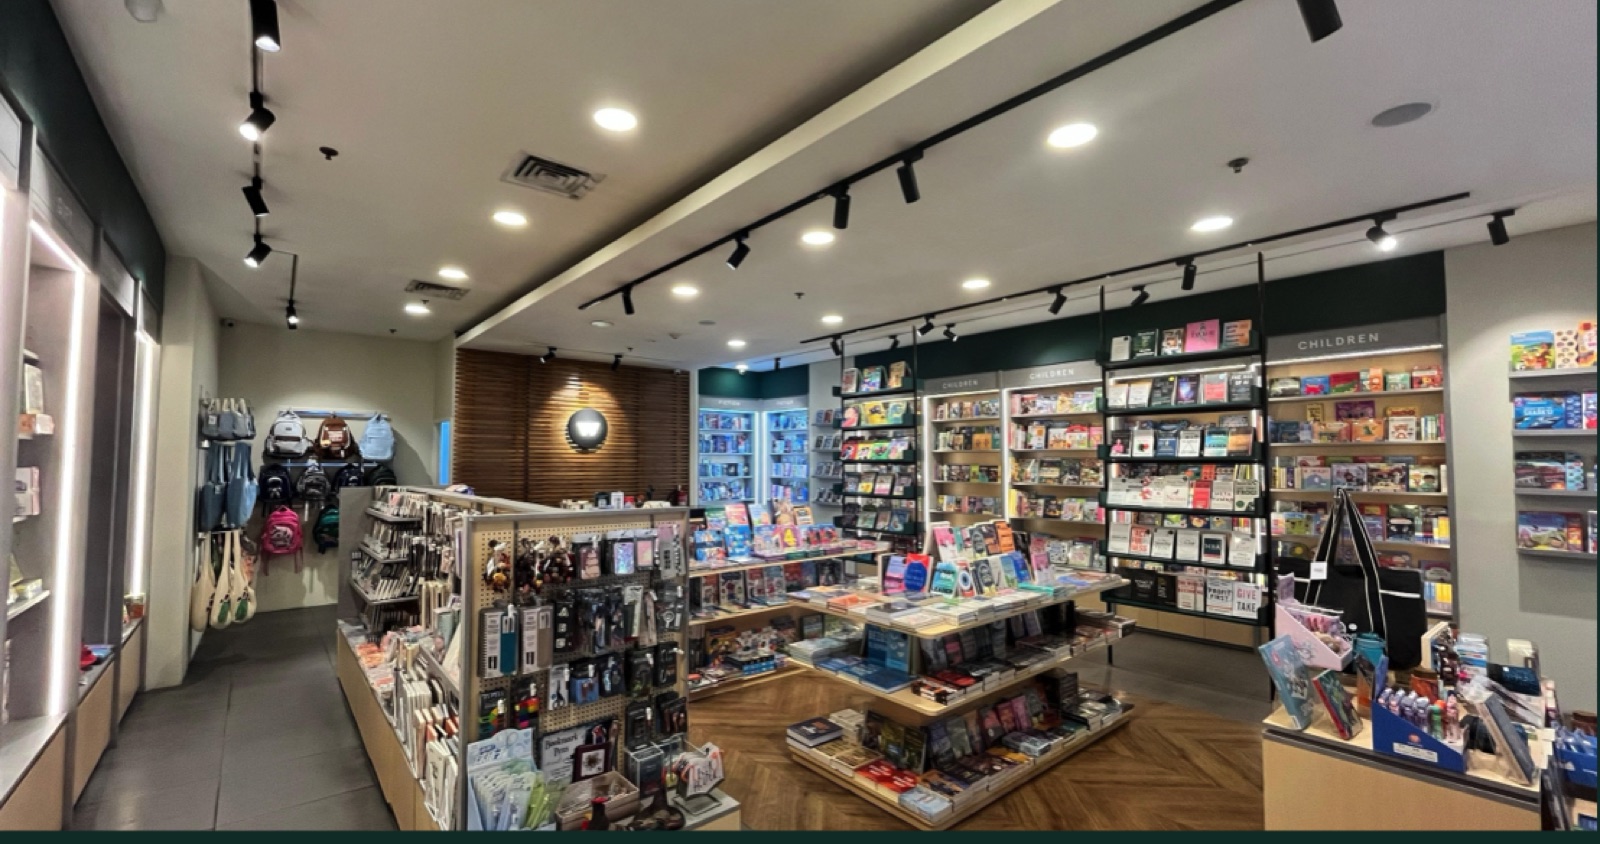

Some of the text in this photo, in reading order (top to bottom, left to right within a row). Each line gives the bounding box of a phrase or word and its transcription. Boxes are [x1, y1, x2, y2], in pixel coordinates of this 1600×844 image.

[1297, 332, 1379, 350] CHILDREN
[1029, 368, 1075, 380] CHILDREN
[942, 379, 979, 389] CHILDREN
[1236, 588, 1256, 600] GIVE
[1236, 601, 1256, 613] TAKE
